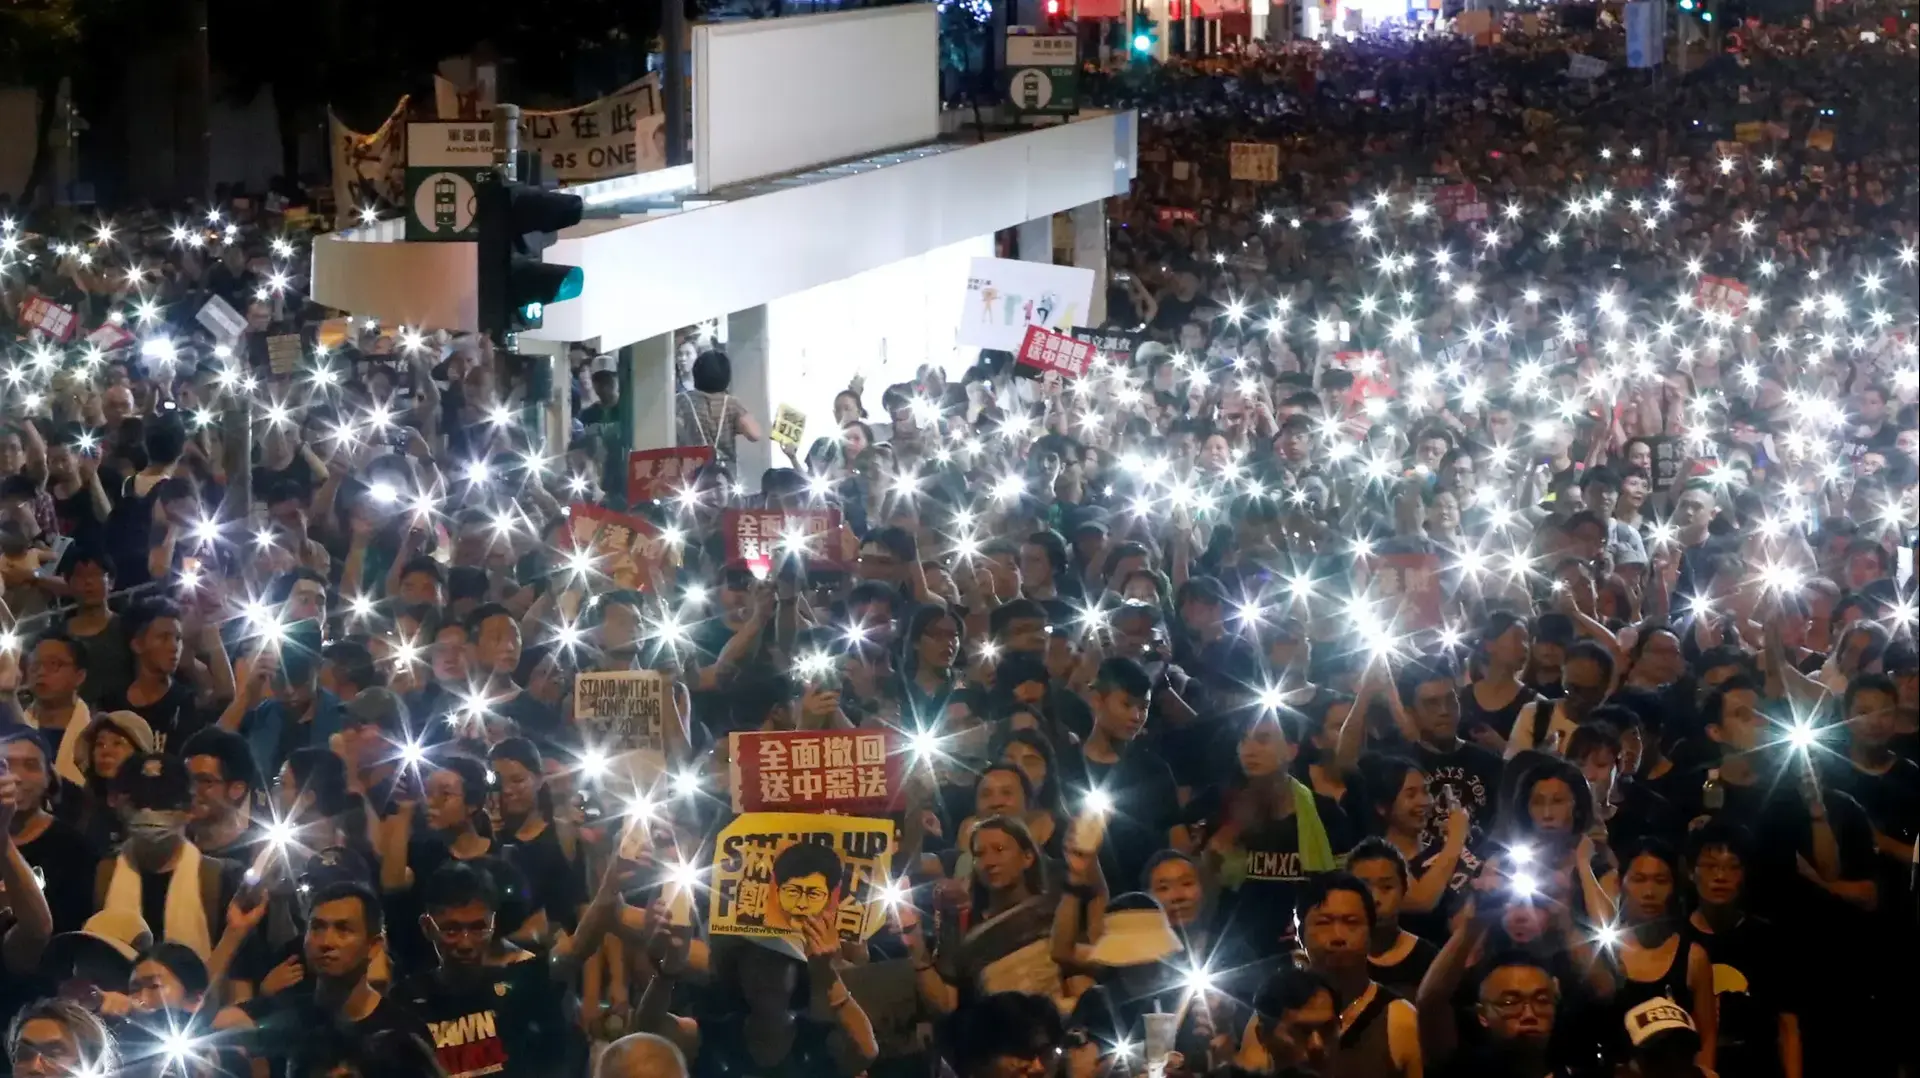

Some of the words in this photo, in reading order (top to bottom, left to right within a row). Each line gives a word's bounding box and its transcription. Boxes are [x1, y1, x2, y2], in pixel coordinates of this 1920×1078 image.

[552, 152, 577, 169] as
[588, 143, 636, 168] ONE
[579, 679, 615, 697] STAND
[618, 679, 649, 697] WITH
[594, 697, 626, 717] HONG
[628, 697, 660, 717] KONG
[758, 735, 886, 771] 全面撤回
[760, 766, 888, 803] 送中惡法
[843, 832, 888, 859] UP
[711, 923, 792, 935] thestandnews.com
